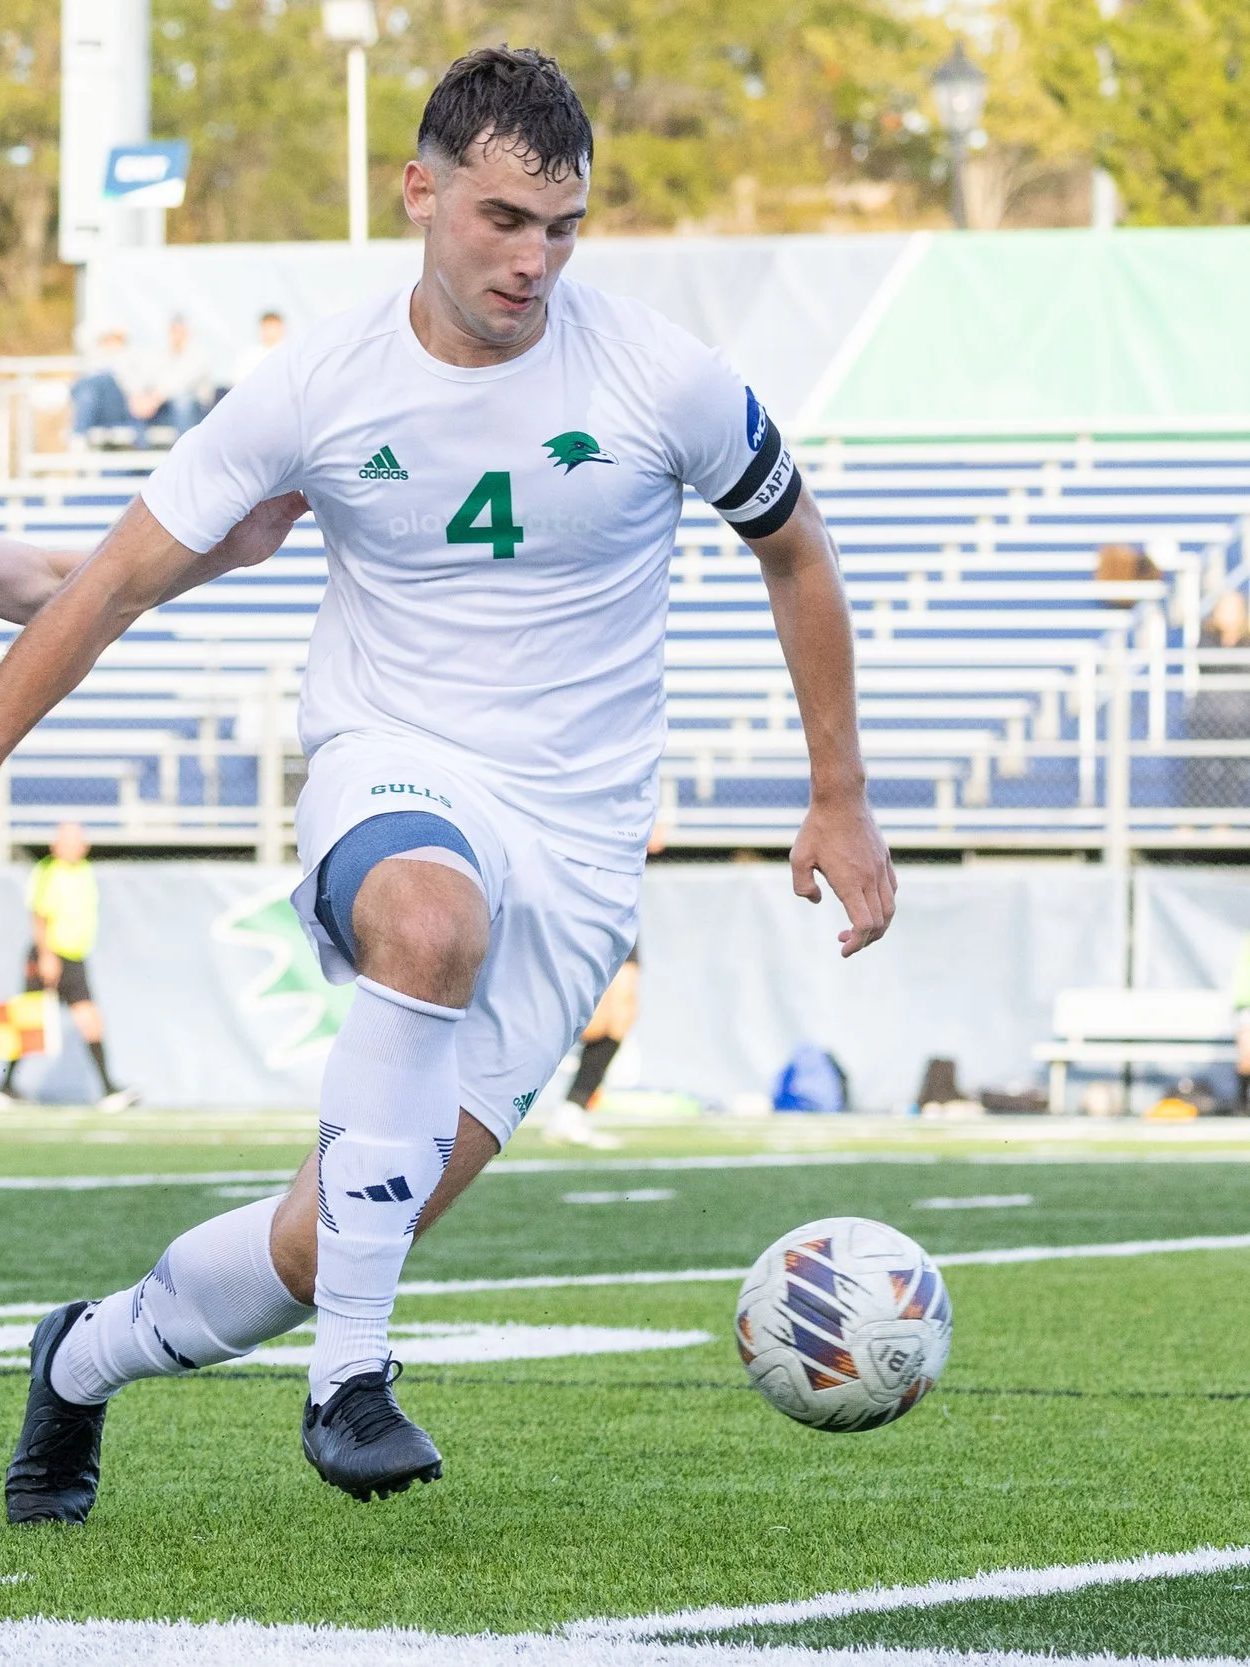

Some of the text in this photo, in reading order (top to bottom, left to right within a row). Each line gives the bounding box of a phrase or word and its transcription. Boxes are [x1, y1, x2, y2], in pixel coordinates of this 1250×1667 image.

[358, 466, 409, 480] adidas
[445, 471, 524, 560] 4
[370, 783, 452, 809] GULLS
